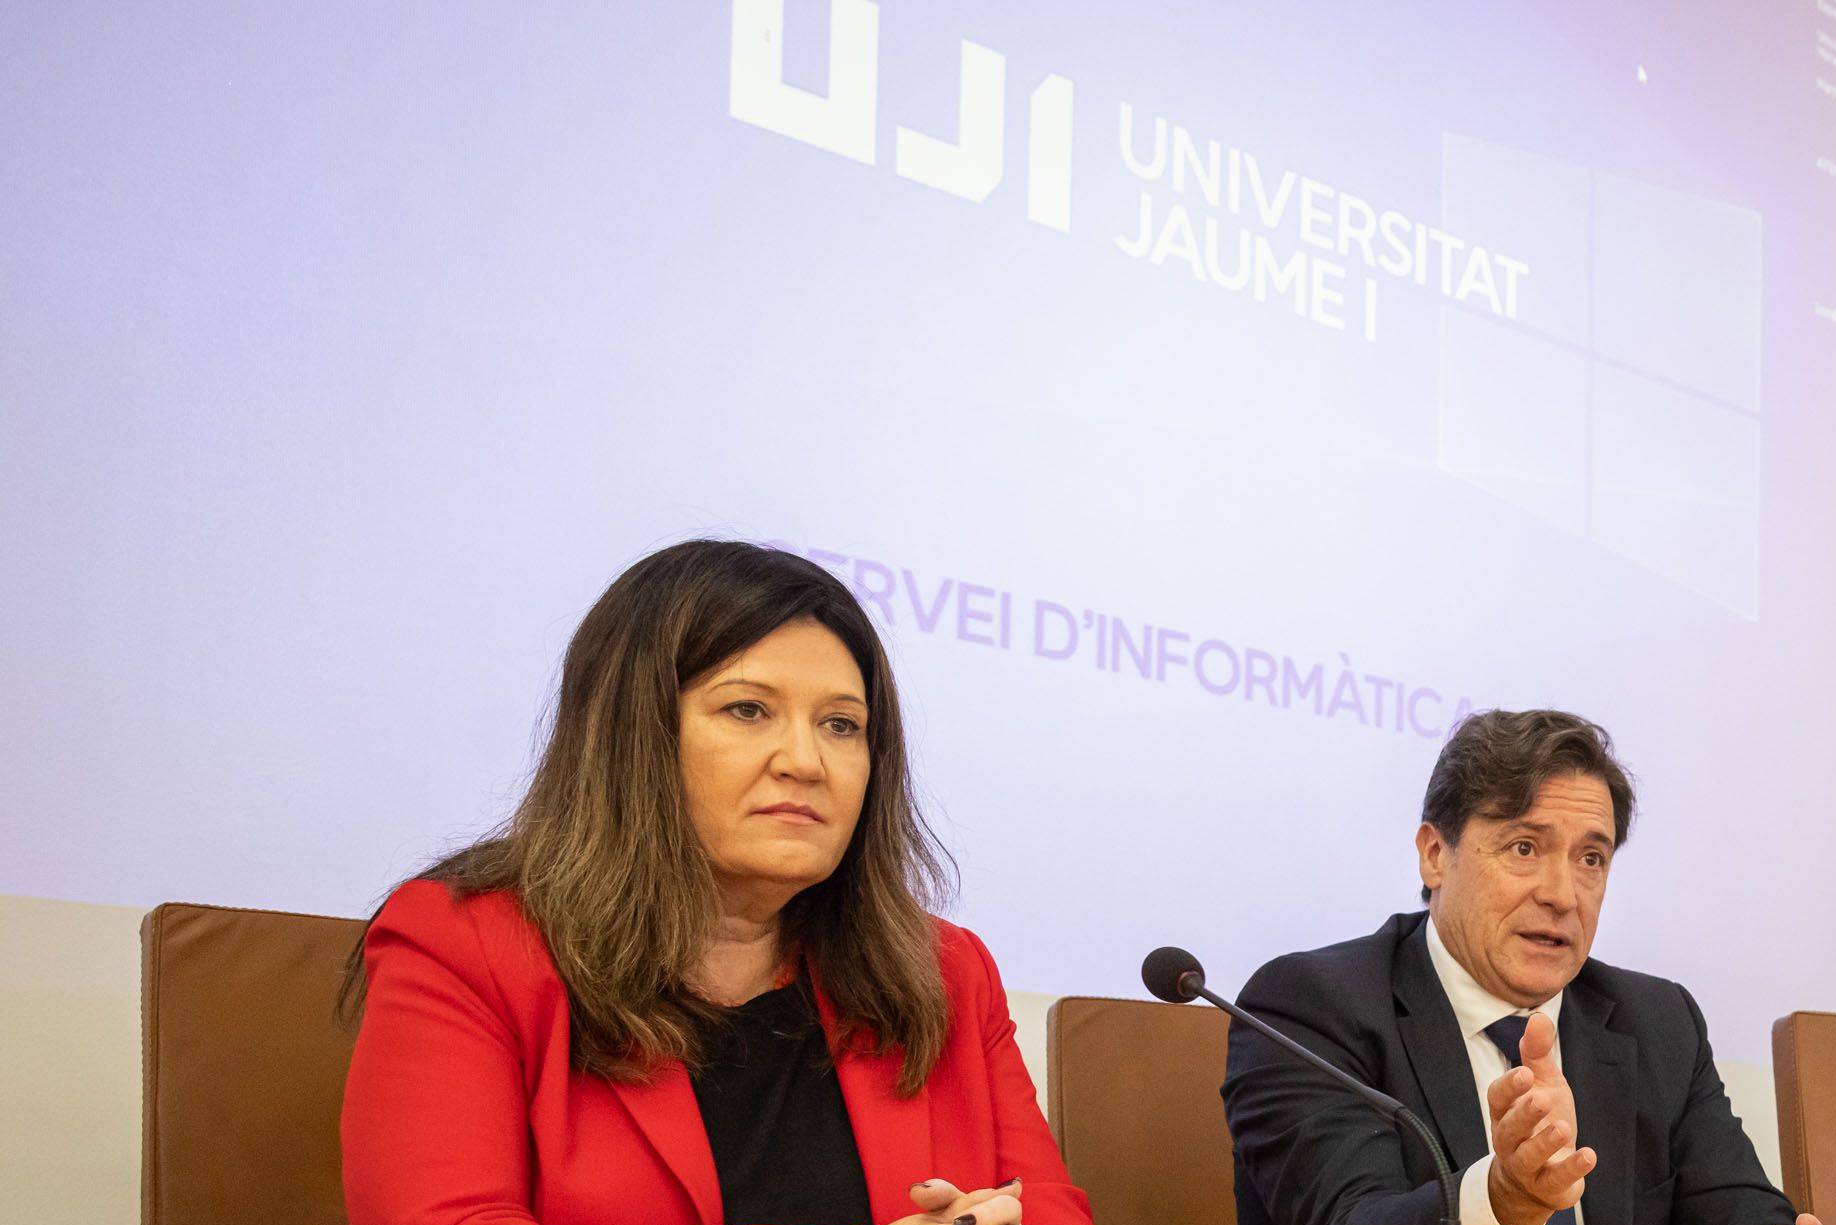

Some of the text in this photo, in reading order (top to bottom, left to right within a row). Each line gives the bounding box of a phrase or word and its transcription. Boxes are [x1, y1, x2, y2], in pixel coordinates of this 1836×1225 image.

[729, 0, 1074, 233] UJI
[1114, 191, 1377, 341] JAUME I
[1118, 101, 1529, 319] UNIVERSITAT
[766, 540, 1012, 650] RVEI
